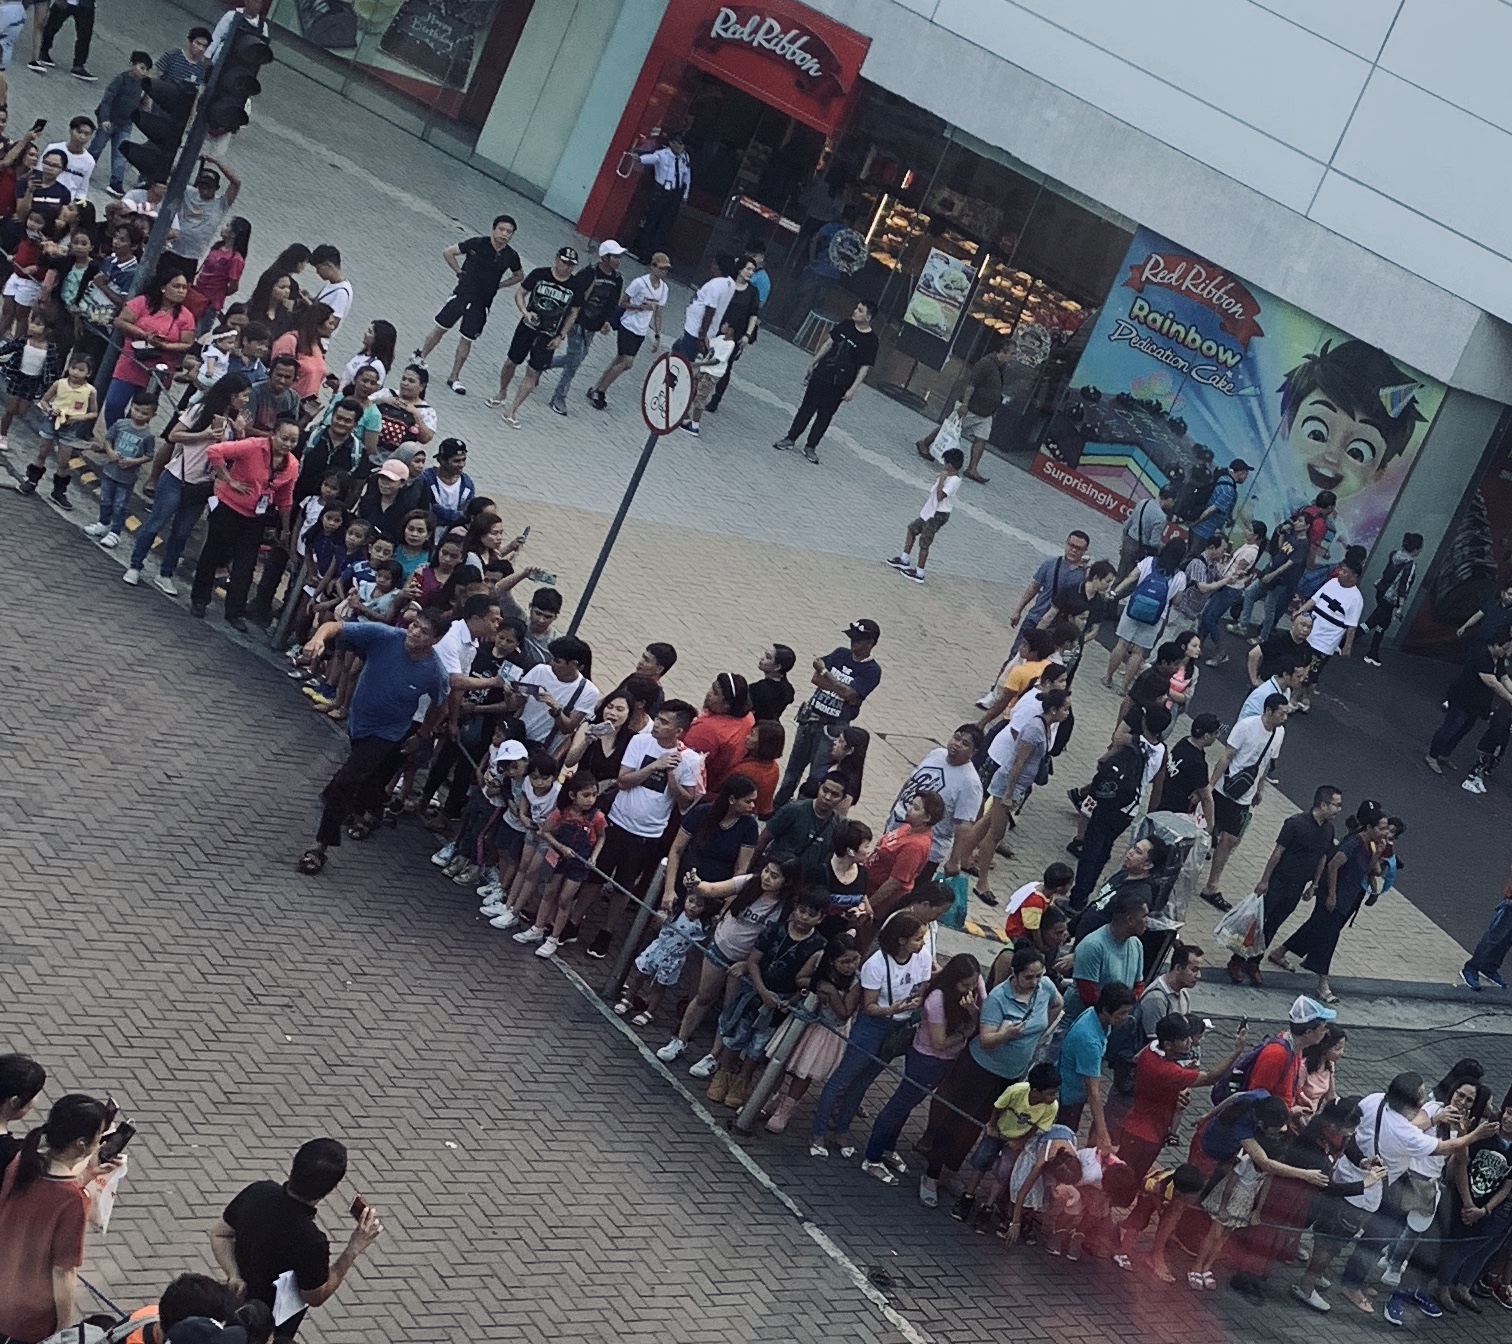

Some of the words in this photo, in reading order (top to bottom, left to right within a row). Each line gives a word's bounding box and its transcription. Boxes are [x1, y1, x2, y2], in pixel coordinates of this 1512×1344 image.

[710, 7, 761, 43] Red
[752, 17, 823, 77] Ribbon
[1140, 254, 1186, 285] Red
[1181, 264, 1246, 319] Ribbon
[1109, 319, 1190, 373] Dedication
[1190, 364, 1236, 397] Cake
[1130, 296, 1242, 369] Rainbow
[1042, 461, 1118, 510] Surprisingly
